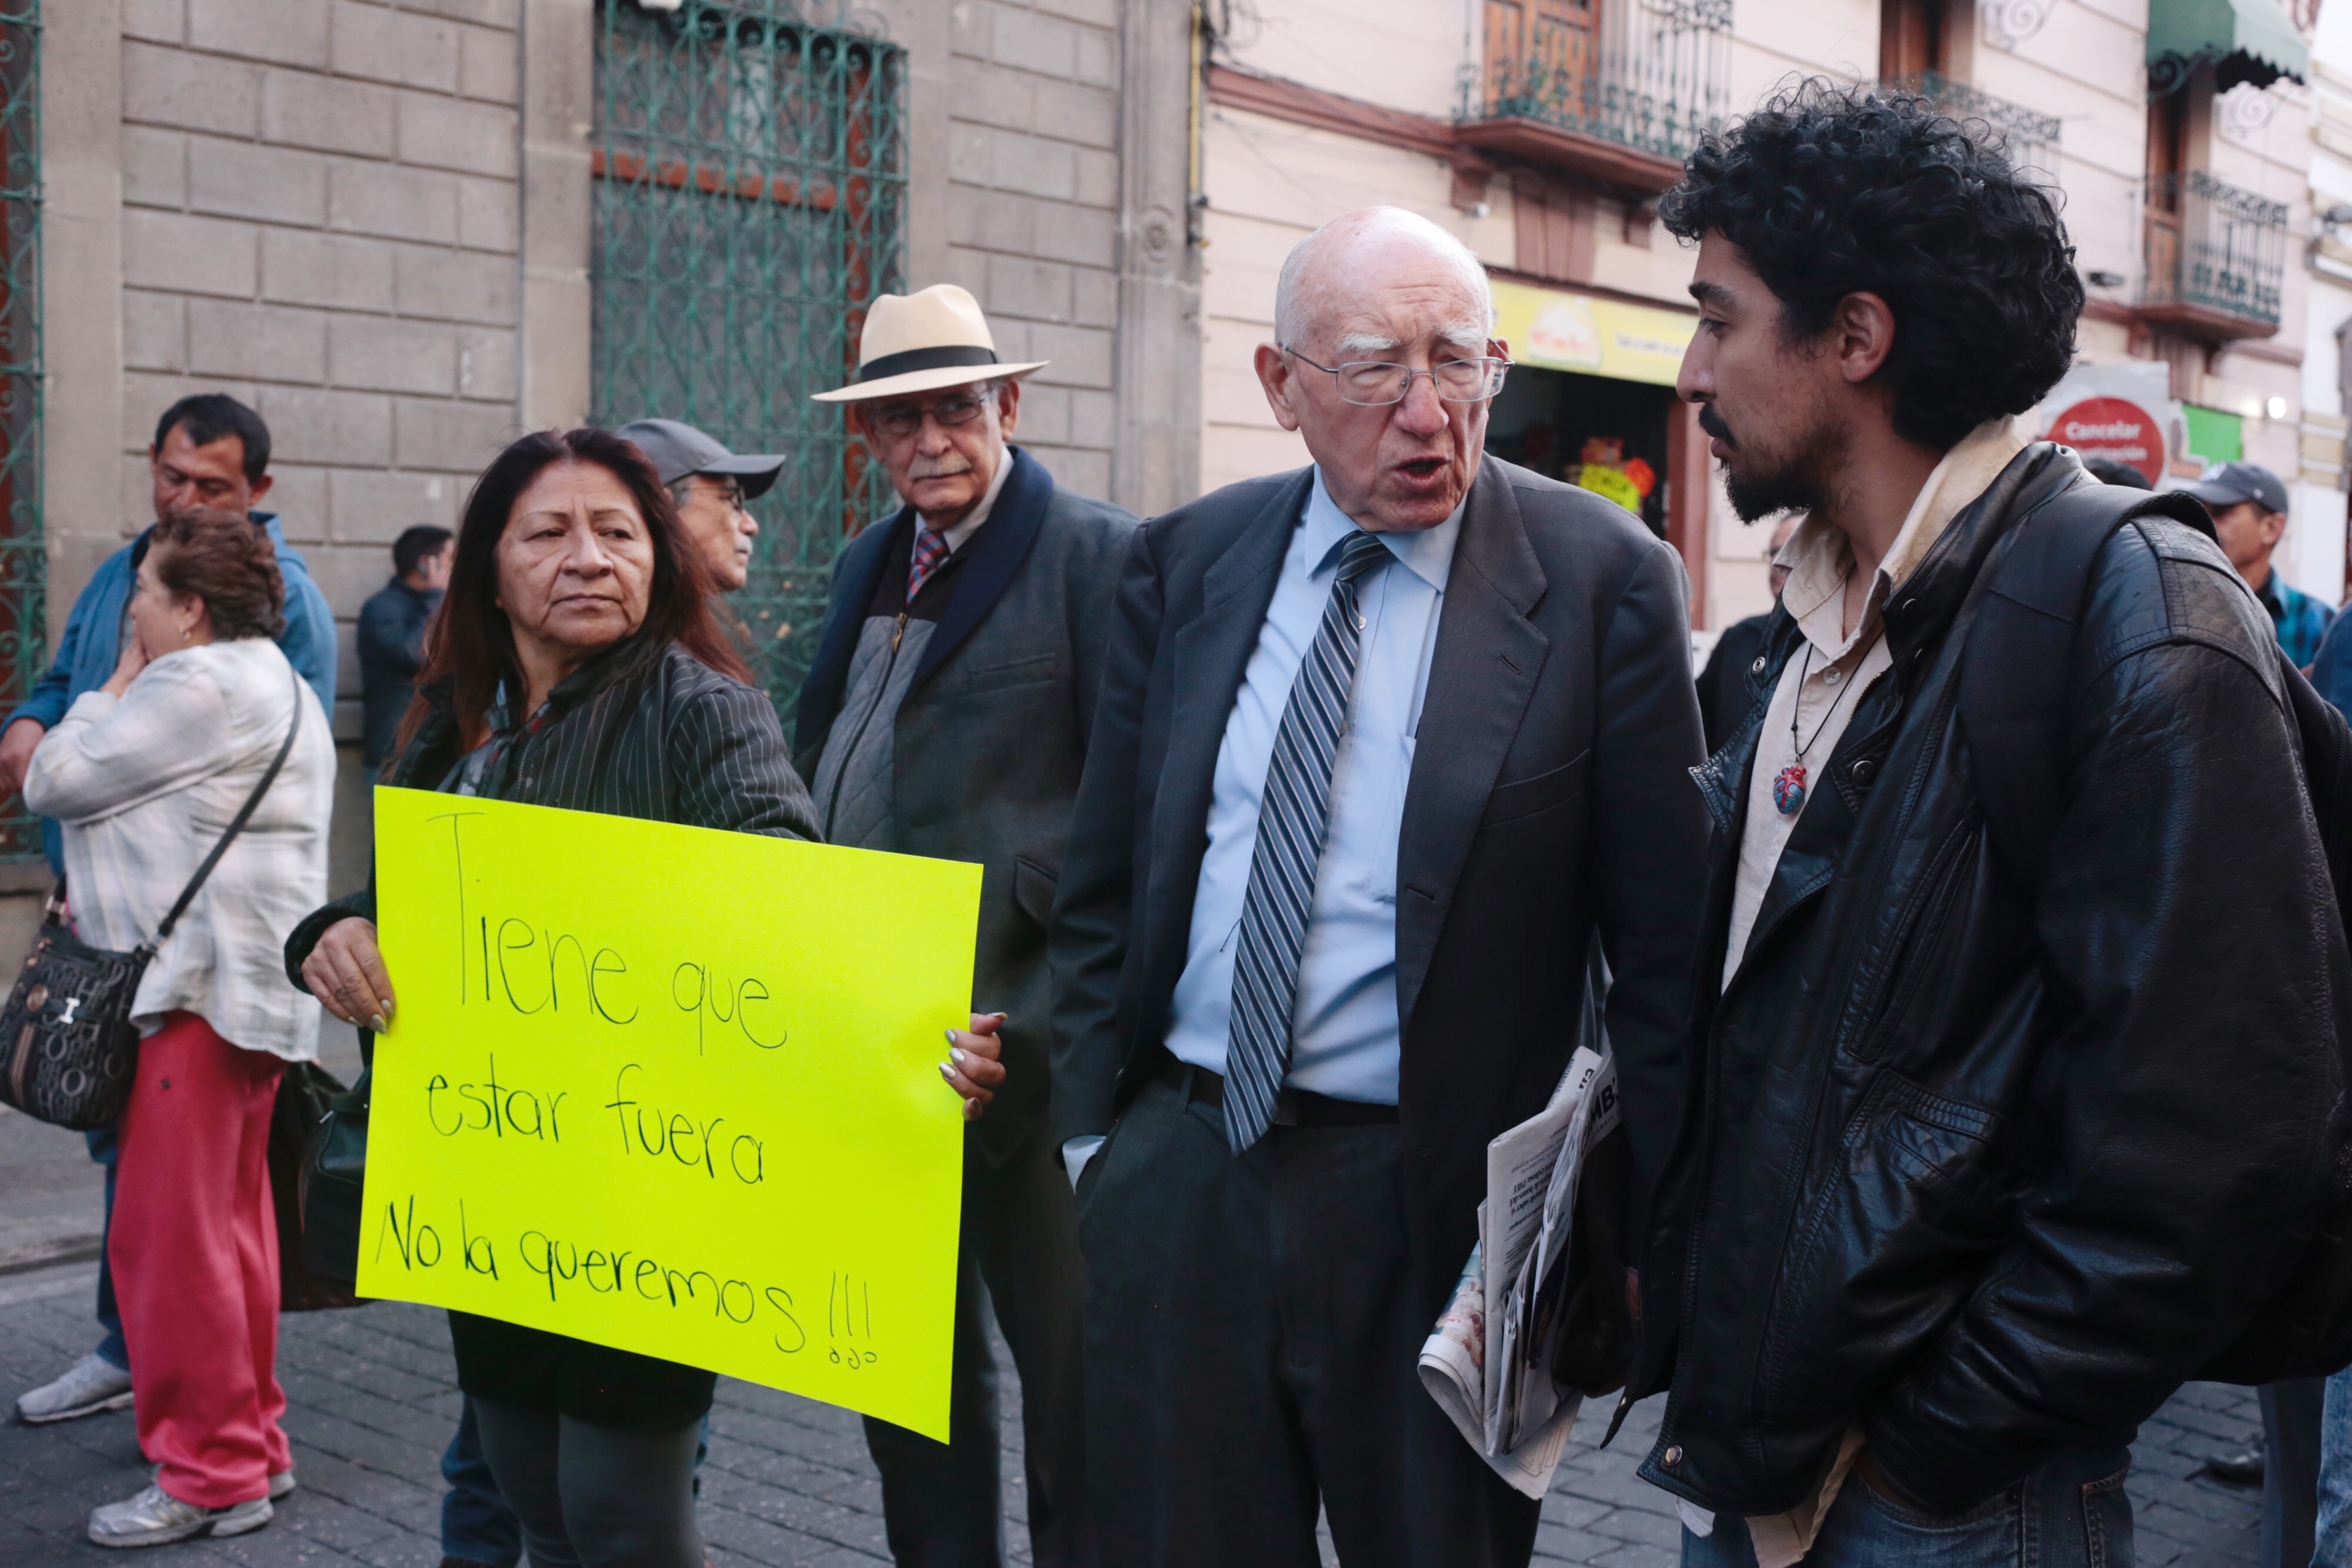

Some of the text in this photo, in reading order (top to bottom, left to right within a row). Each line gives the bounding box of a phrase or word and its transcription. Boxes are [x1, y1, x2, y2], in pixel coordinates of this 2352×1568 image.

[2065, 419, 2142, 441] Cancelar
[426, 812, 787, 1056] Tiene que
[426, 1052, 764, 1185] estar fuera
[376, 1195, 441, 1271] No
[460, 1199, 499, 1281] la
[520, 1231, 805, 1353] queremos
